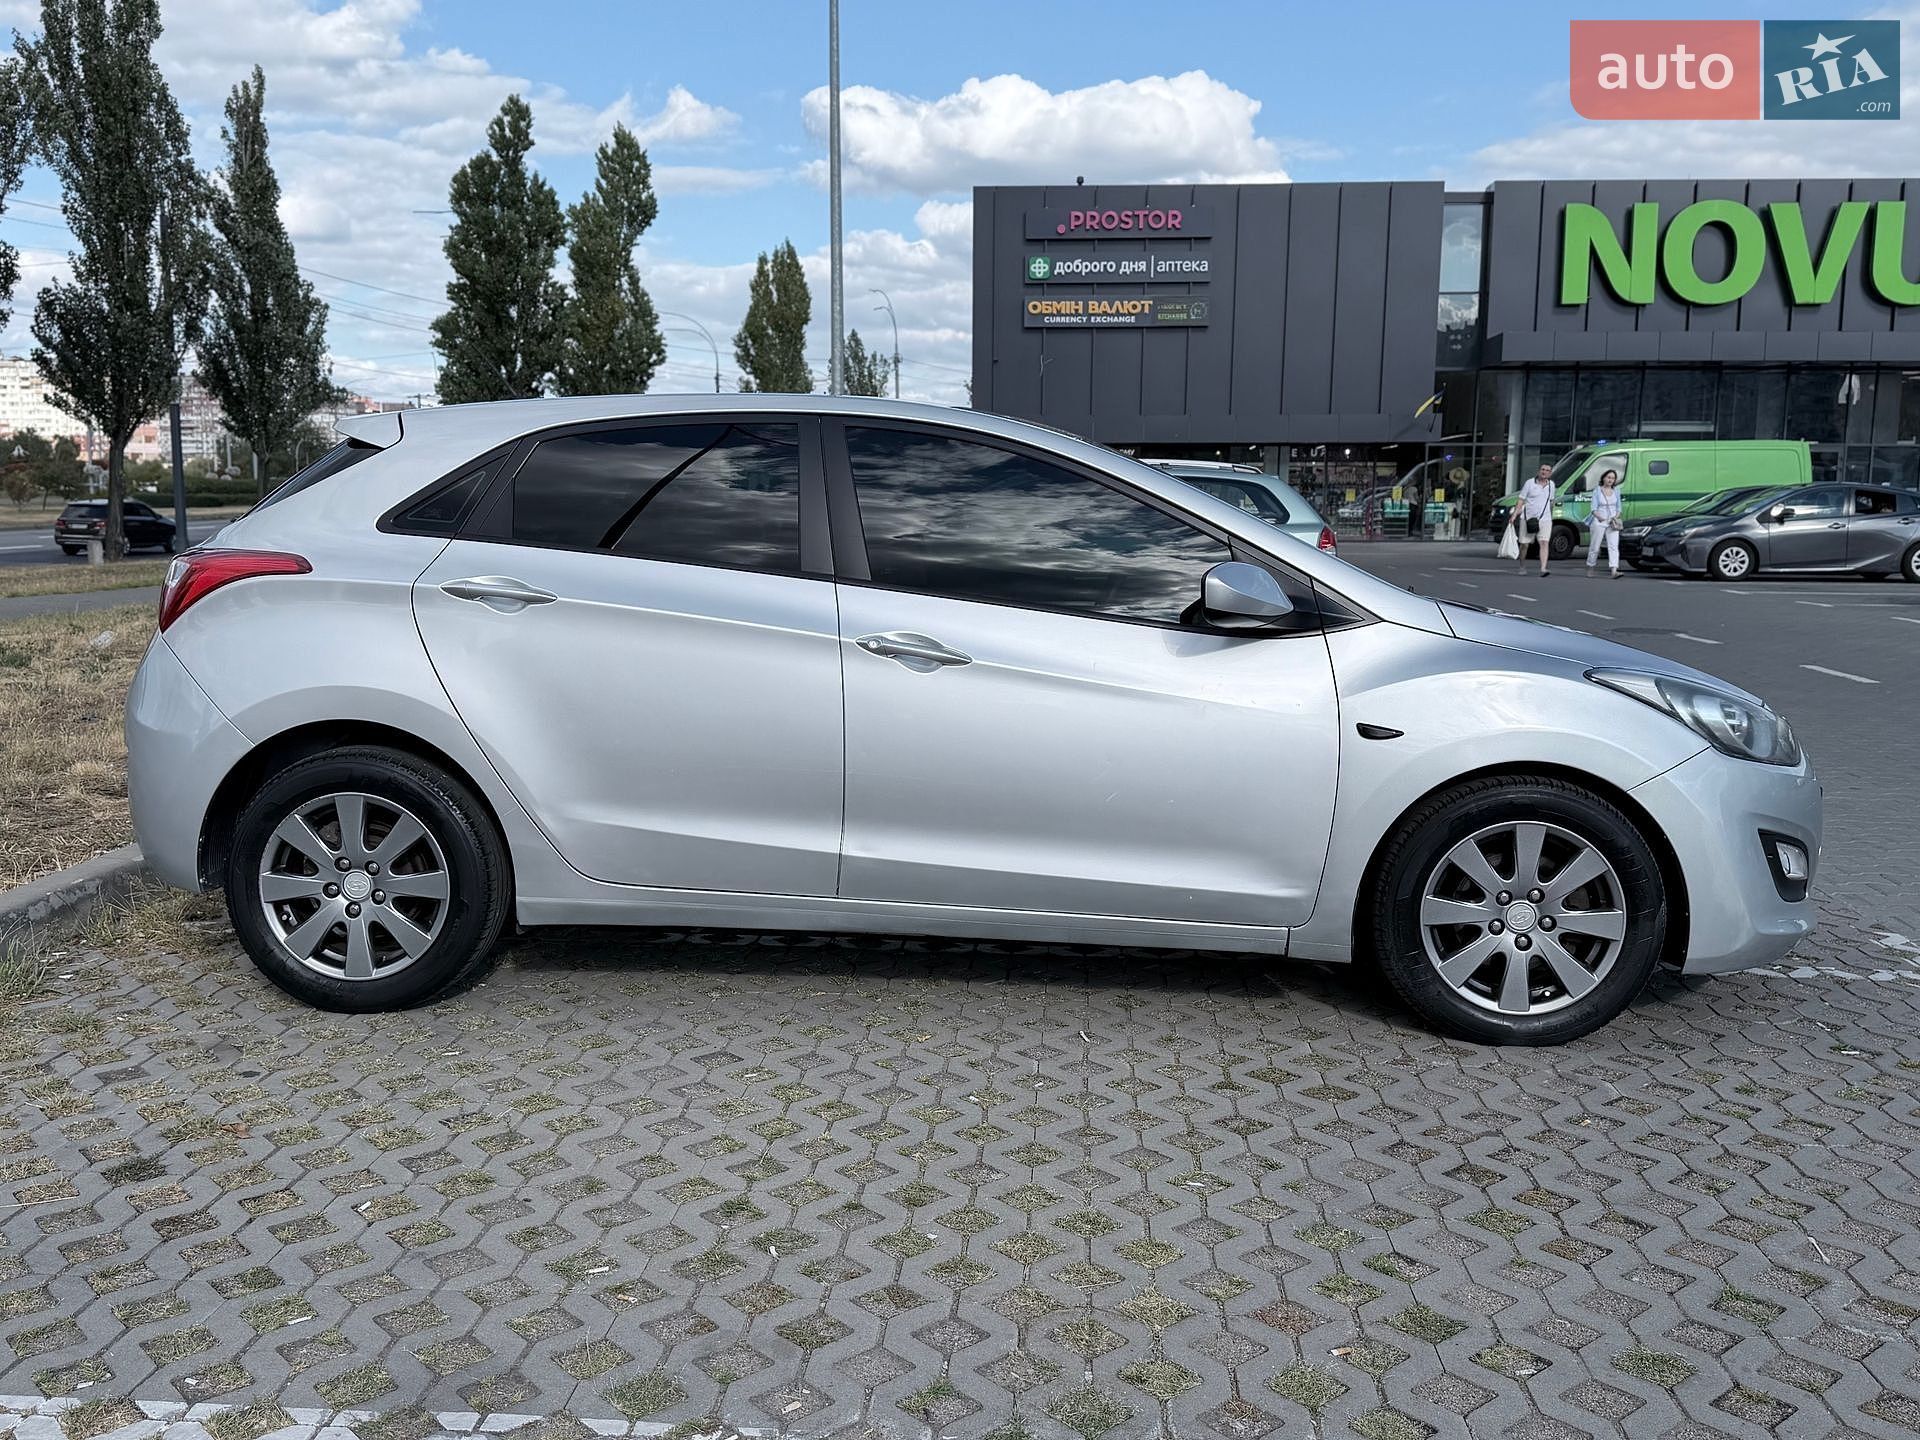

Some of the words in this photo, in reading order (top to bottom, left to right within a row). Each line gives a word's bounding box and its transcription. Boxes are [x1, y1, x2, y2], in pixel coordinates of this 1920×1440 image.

[1054, 259, 1116, 276] доброго
[1119, 261, 1147, 275] дня
[1156, 260, 1209, 272] аптека
[1027, 300, 1083, 314] ОБМІН
[1088, 300, 1153, 314] ВАЛЮТ
